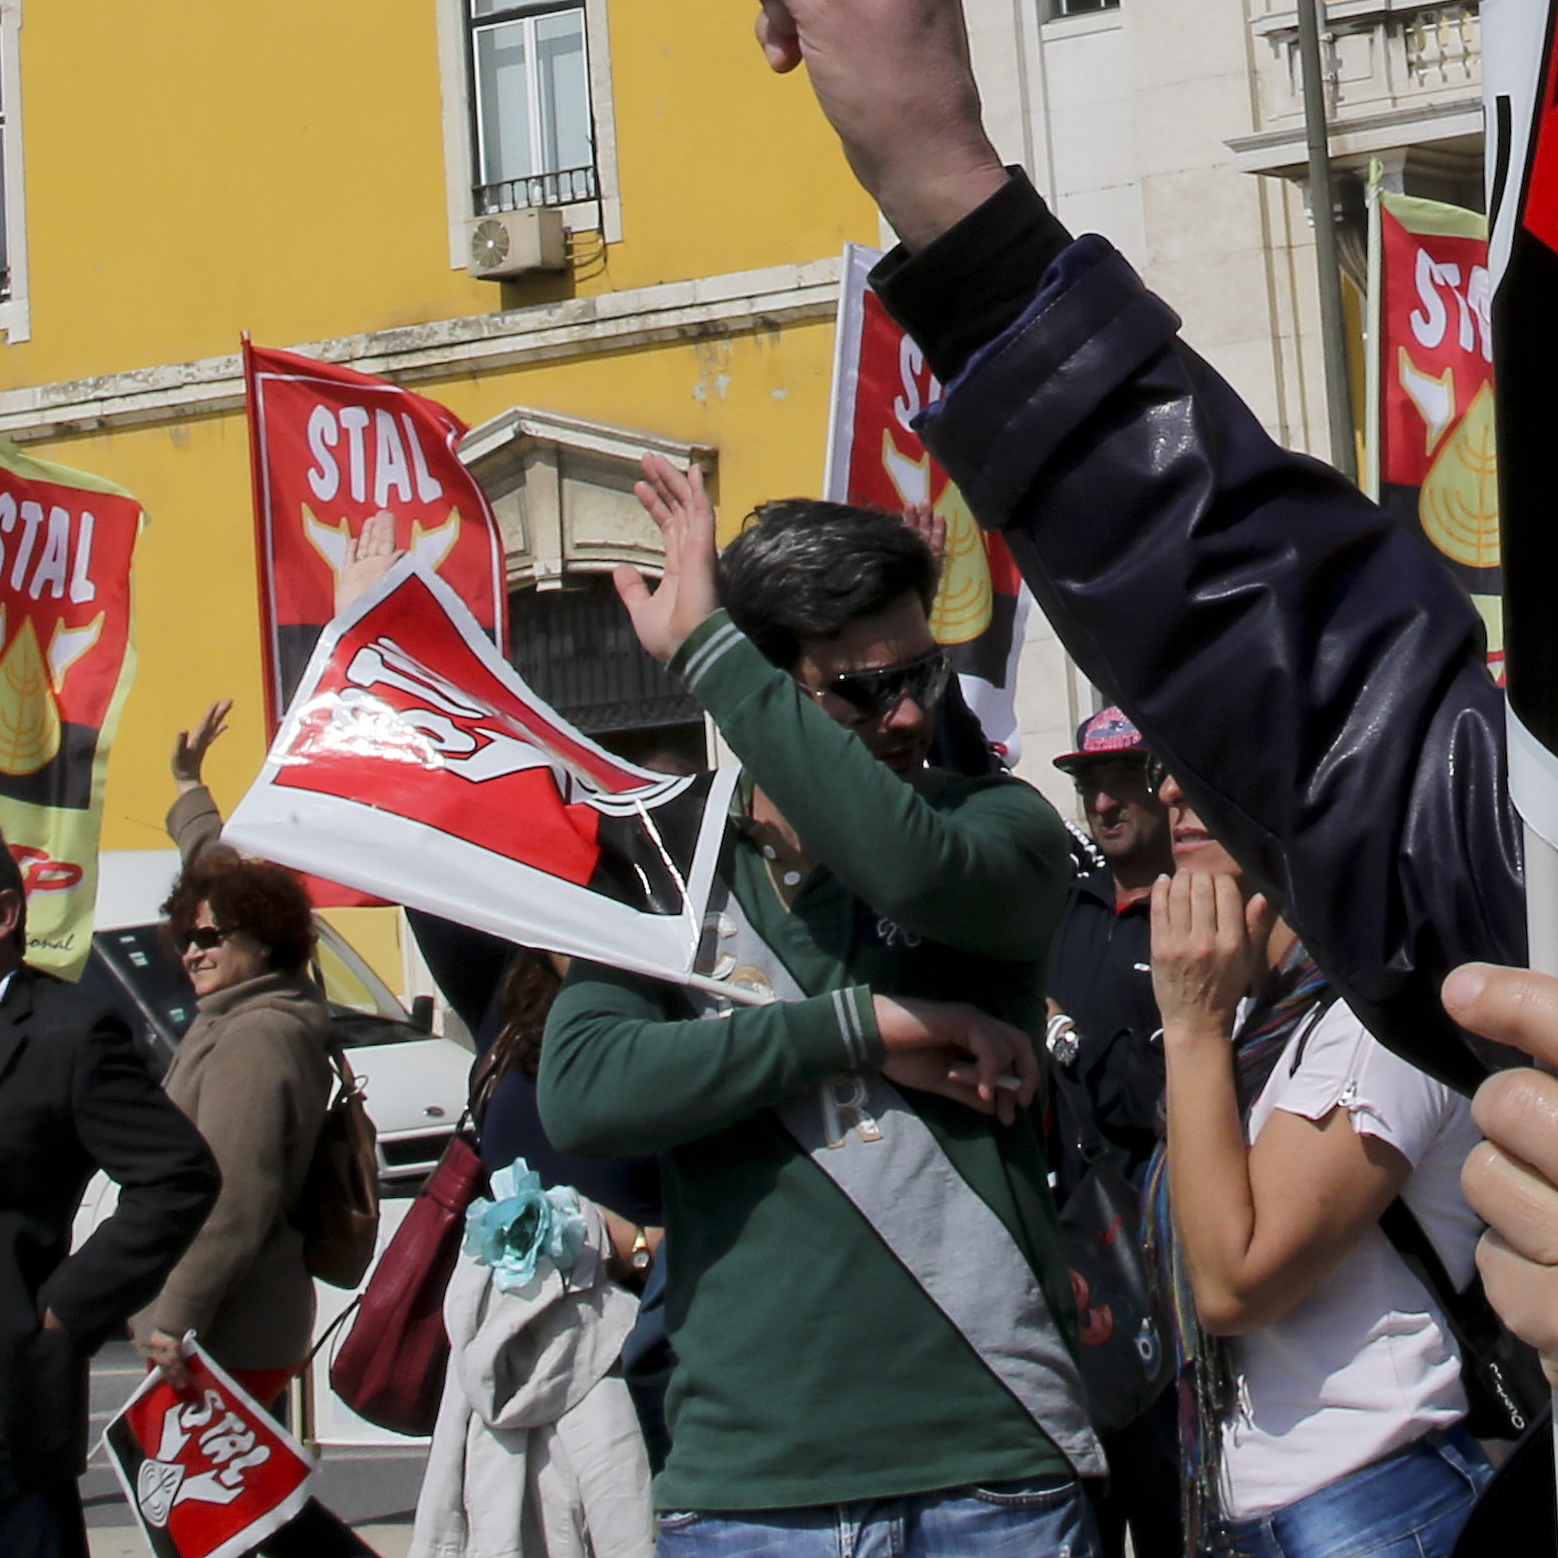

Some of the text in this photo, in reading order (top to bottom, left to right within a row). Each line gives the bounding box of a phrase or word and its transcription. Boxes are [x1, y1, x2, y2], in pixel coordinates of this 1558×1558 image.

[1409, 247, 1493, 363] STA
[307, 403, 444, 509] STAL
[180, 1388, 272, 1487] STAL
